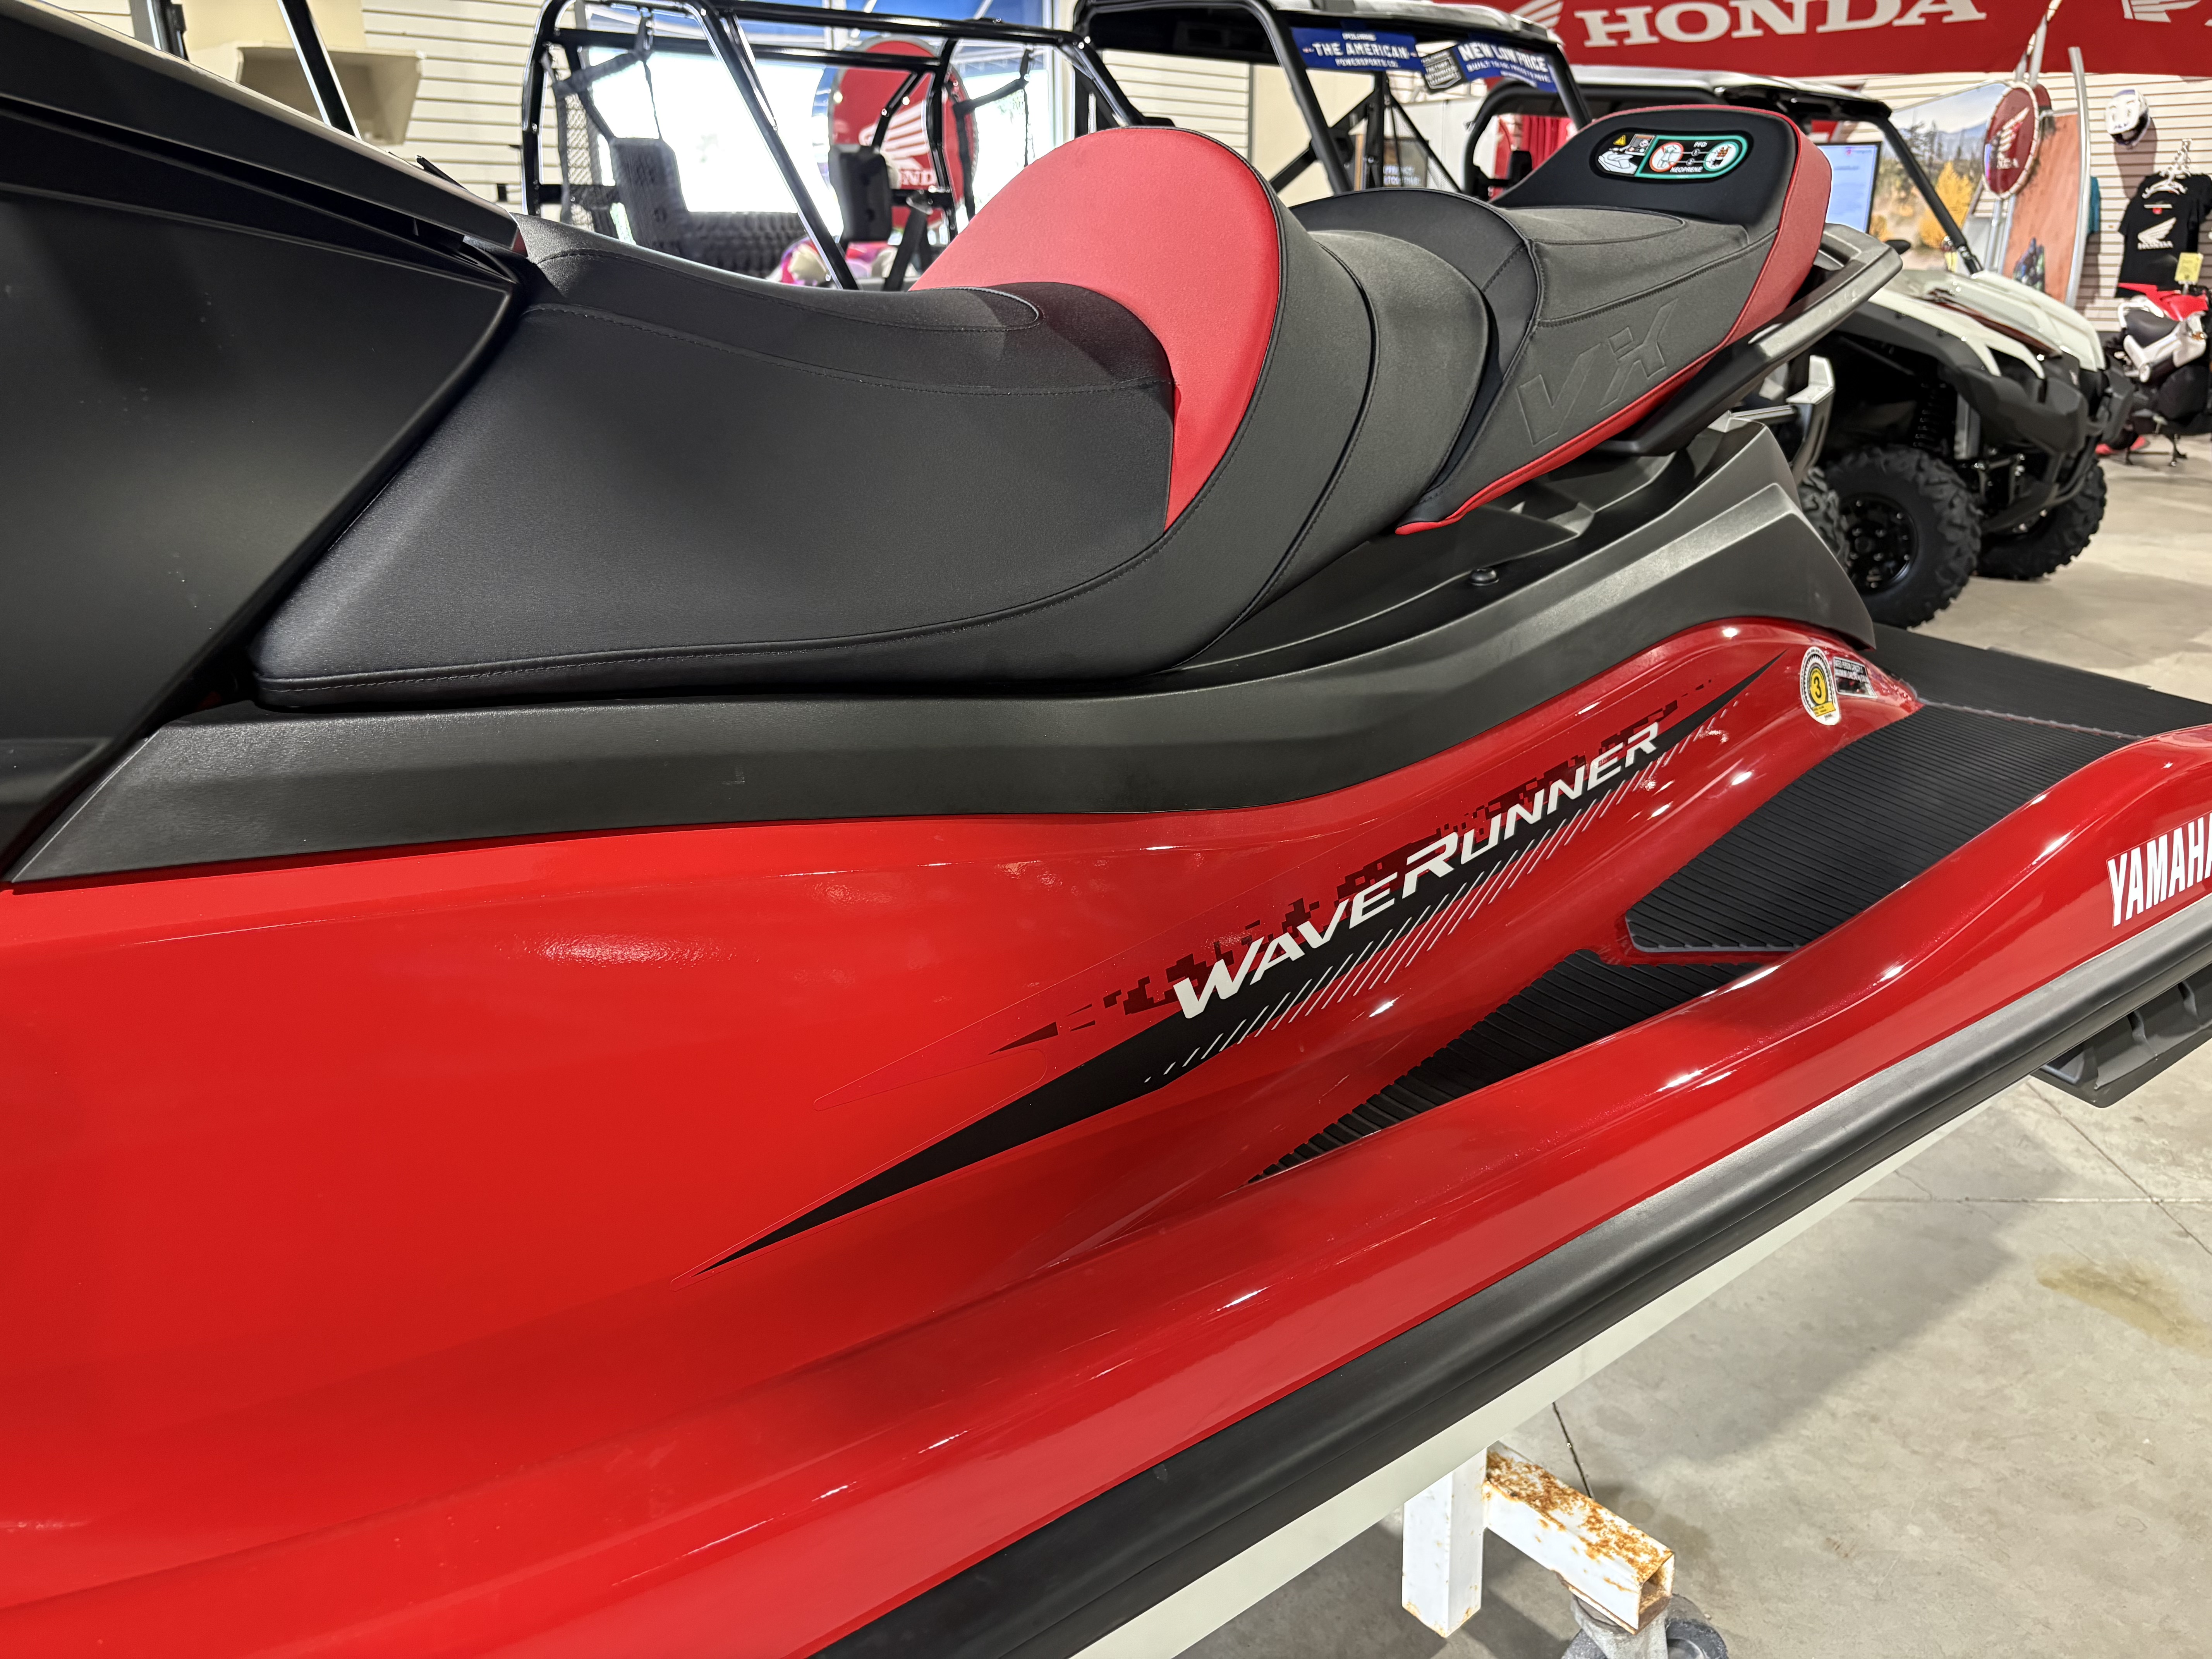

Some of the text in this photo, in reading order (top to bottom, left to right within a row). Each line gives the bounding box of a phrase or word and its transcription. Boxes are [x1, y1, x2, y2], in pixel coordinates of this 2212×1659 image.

[1575, 0, 1987, 47] HONDA
[1312, 41, 1343, 57] THE
[1346, 42, 1409, 59] AMERICAN
[1458, 42, 1494, 61] NEW
[1491, 45, 1517, 64] LOW
[1516, 52, 1548, 72] PRICE
[1814, 676, 1822, 699] 3
